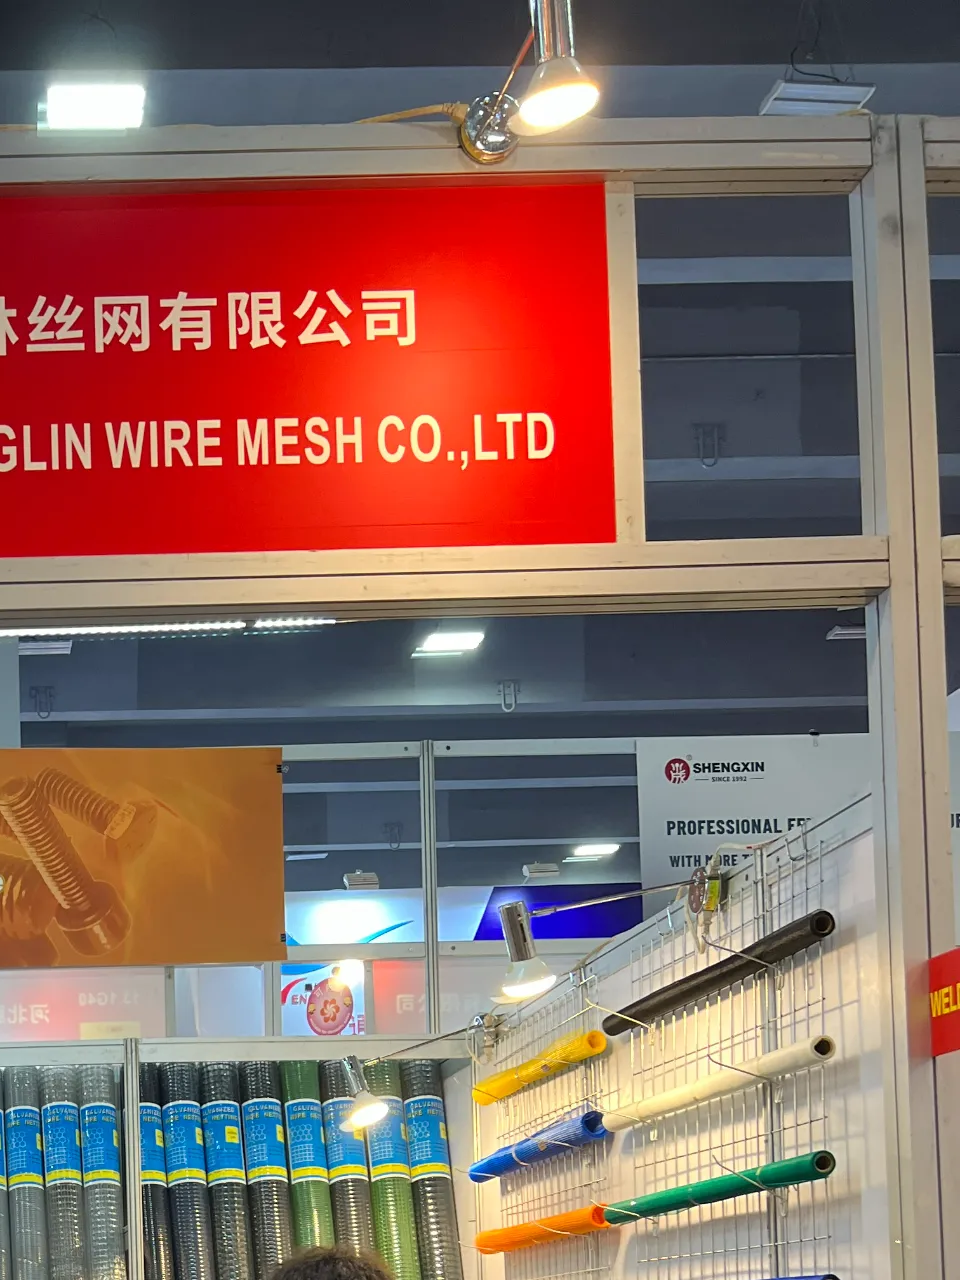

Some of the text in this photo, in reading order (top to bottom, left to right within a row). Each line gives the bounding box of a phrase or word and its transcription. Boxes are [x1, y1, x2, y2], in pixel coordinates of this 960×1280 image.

[105, 419, 223, 469] WIRE
[236, 416, 363, 466] MESH
[377, 412, 556, 471] CO.,LTD
[693, 761, 765, 774] SHENGXIN
[666, 818, 782, 836] PROFESSIONAL
[669, 855, 701, 868] WITH
